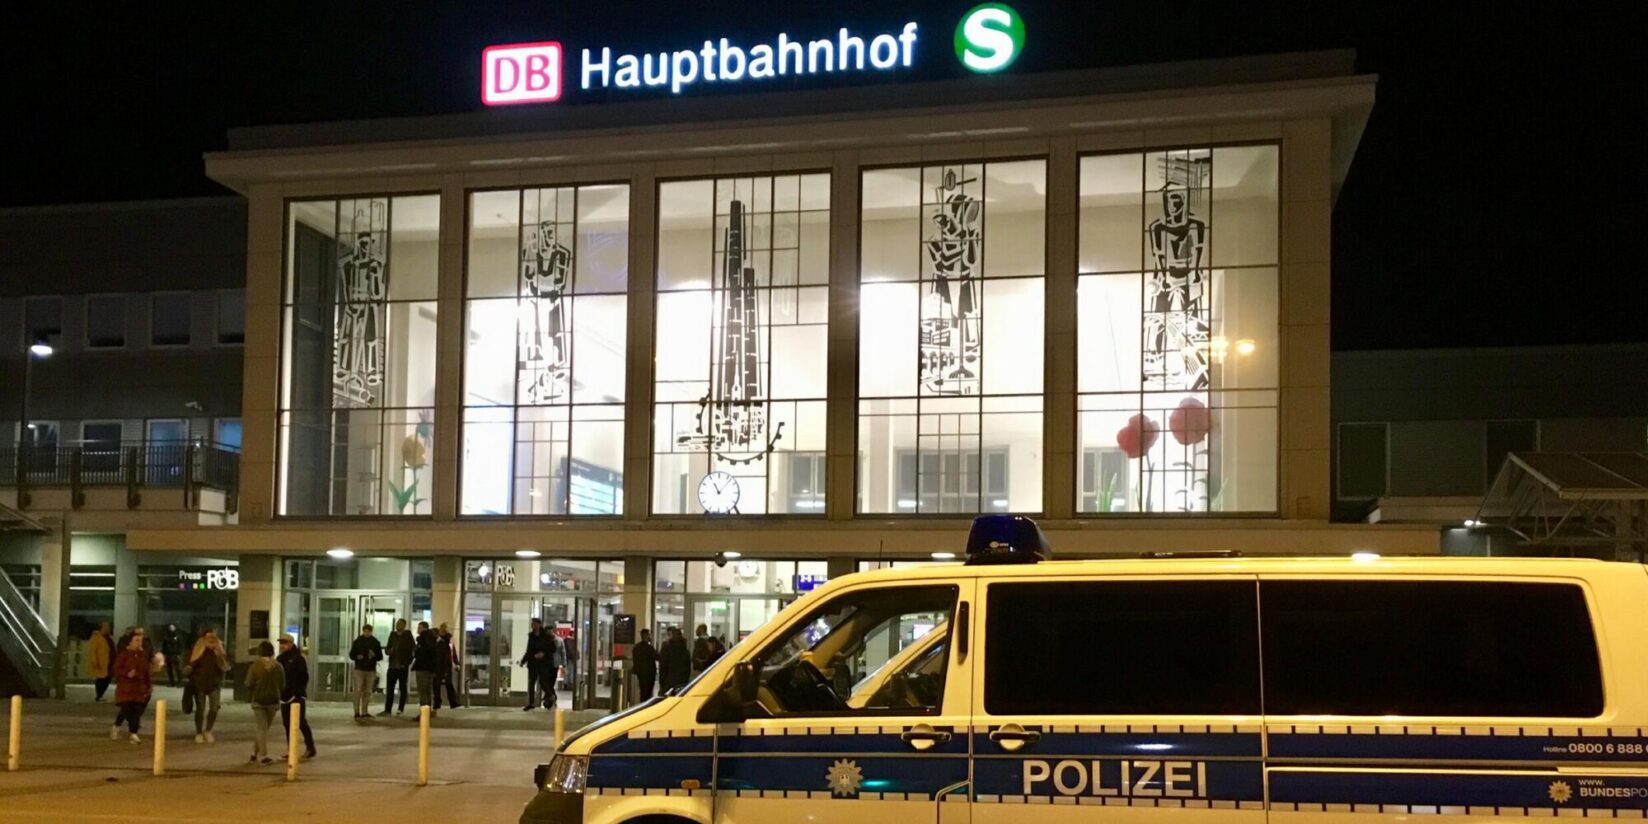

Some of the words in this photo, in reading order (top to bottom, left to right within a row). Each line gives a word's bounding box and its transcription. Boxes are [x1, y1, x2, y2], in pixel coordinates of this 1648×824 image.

[494, 54, 551, 94] DB
[581, 22, 918, 94] Hauptbahnhof
[963, 7, 1014, 70] S
[179, 570, 201, 580] Press
[1568, 743, 1603, 753] 0800
[1606, 743, 1614, 754] 6
[1617, 743, 1643, 754] 888
[1023, 759, 1207, 797] POLIZEI
